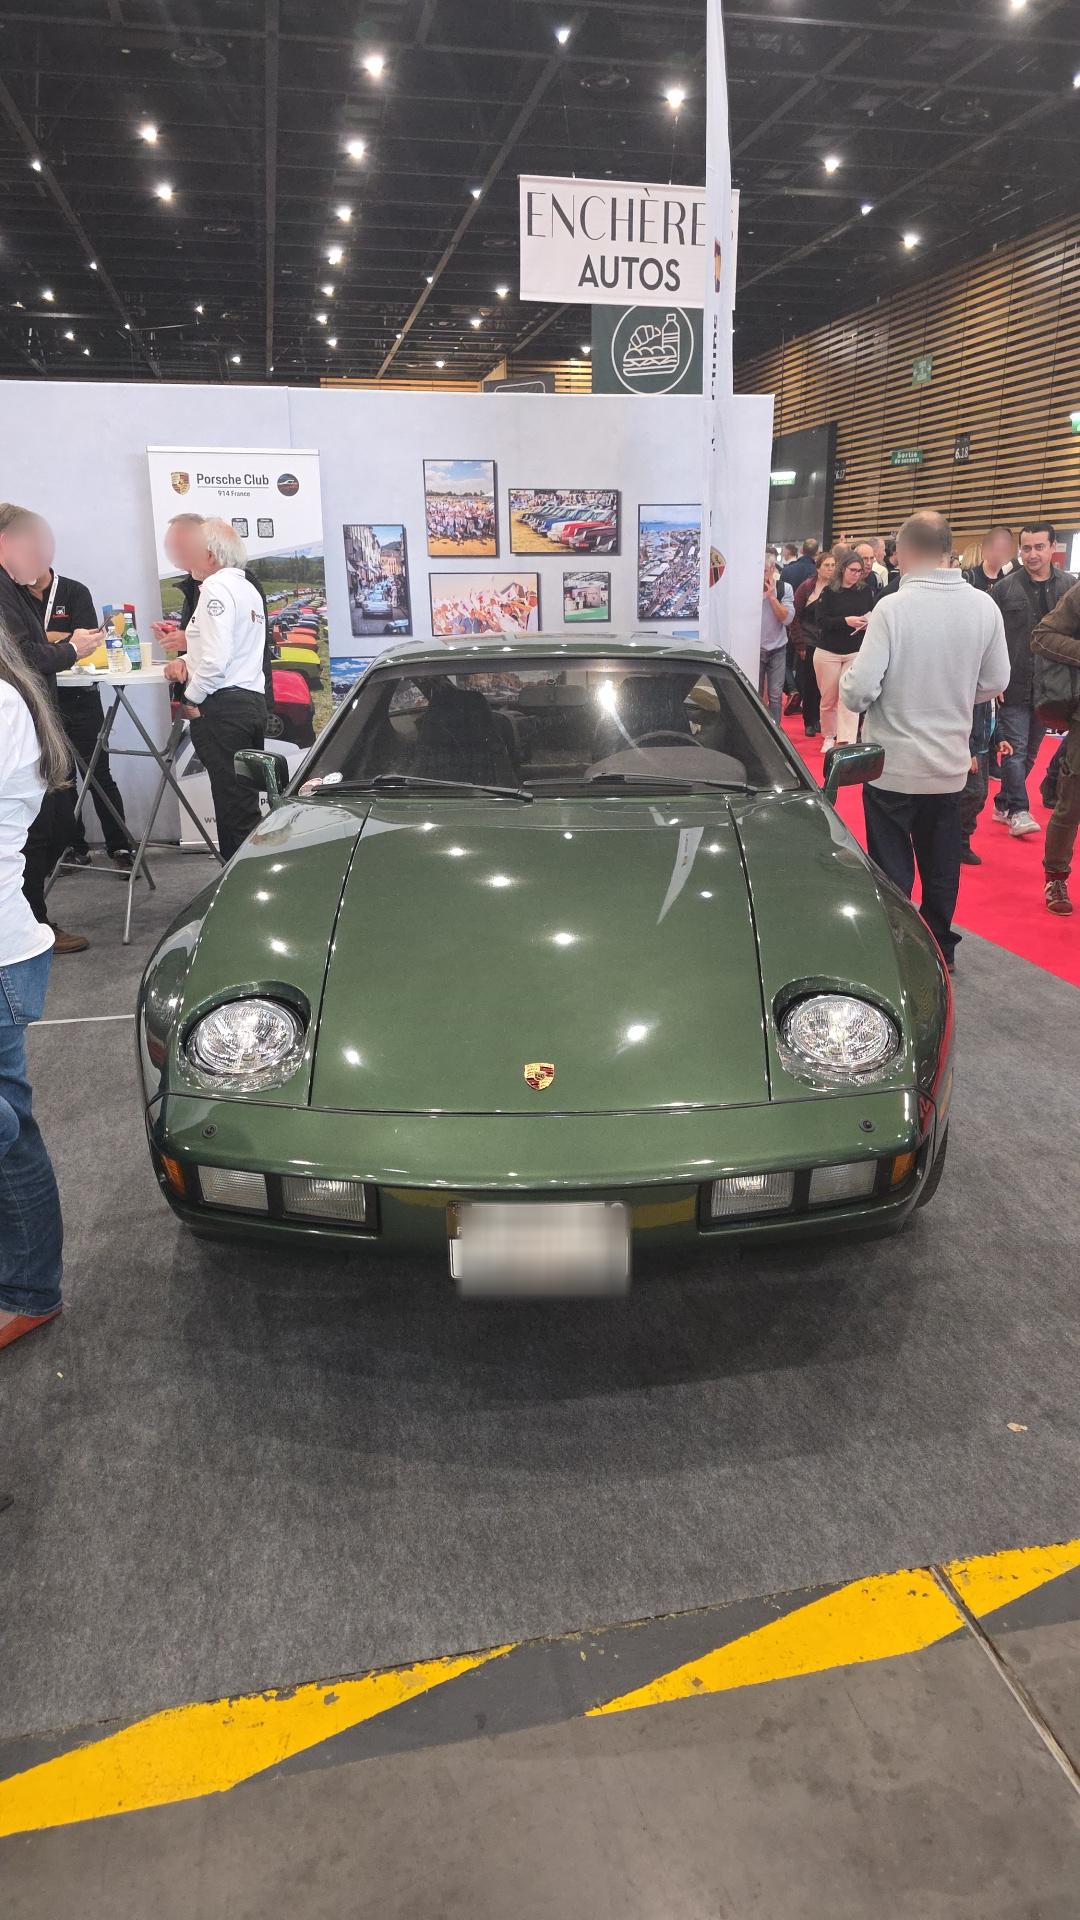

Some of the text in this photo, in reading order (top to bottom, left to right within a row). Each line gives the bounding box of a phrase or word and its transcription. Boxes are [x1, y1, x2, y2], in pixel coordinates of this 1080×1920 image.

[526, 187, 733, 247] ENCHÈRE
[577, 254, 681, 292] AUTOS
[196, 473, 269, 485] Porsche Club
